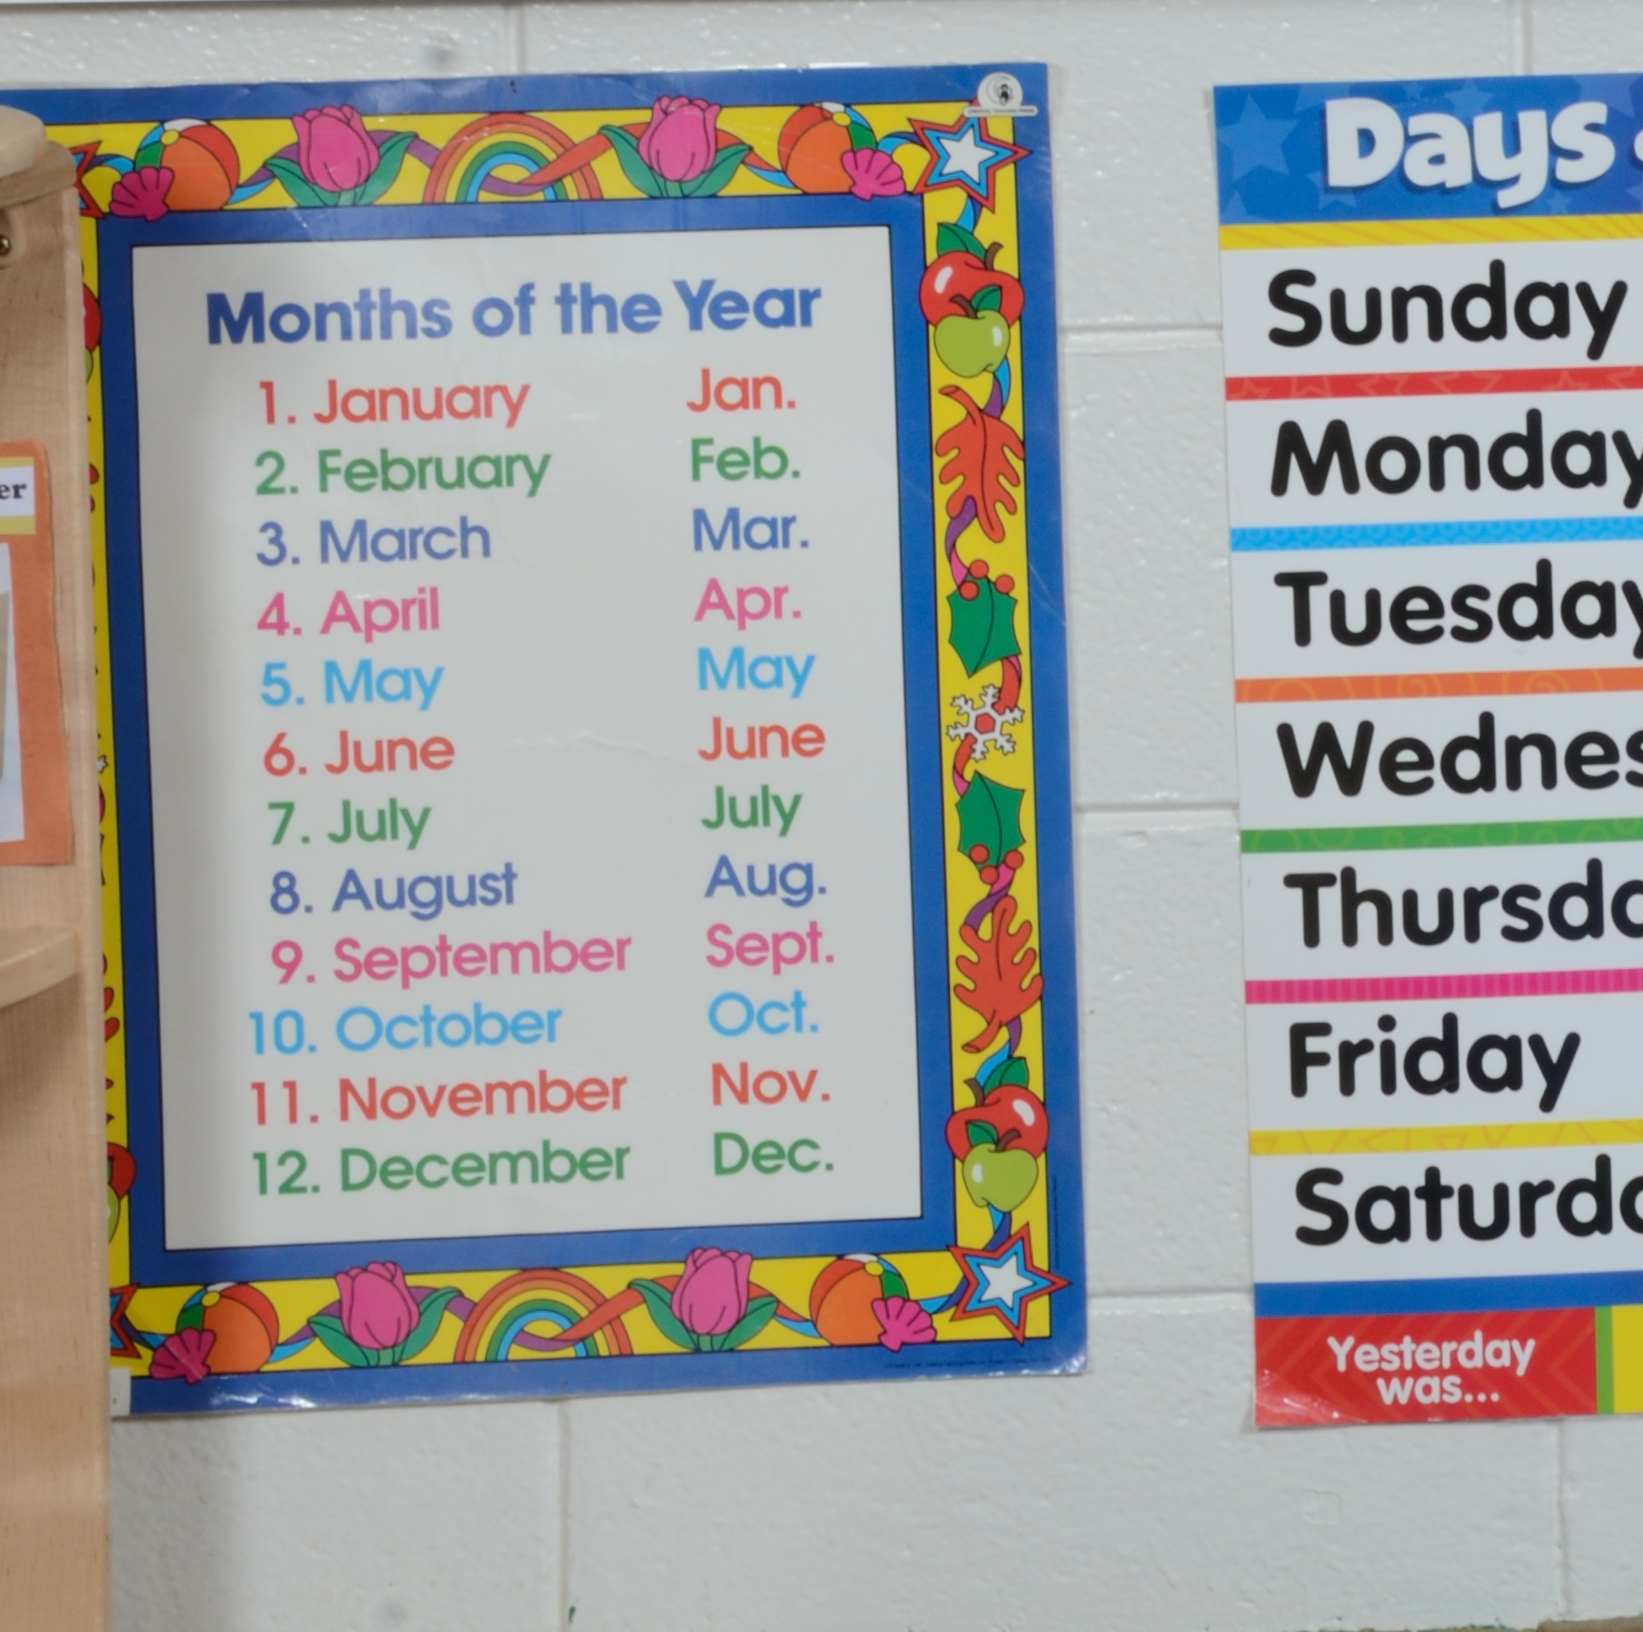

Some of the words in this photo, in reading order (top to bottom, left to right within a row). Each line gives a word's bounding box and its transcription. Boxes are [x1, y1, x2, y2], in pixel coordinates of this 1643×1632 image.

[1323, 98, 1615, 208] Days
[205, 289, 452, 346] Months
[472, 282, 536, 338] of
[554, 282, 662, 334] the
[673, 279, 821, 331] Year
[1268, 259, 1628, 360] Sunday
[259, 381, 296, 425] 1.
[313, 379, 530, 428] January
[687, 368, 796, 413] Jan.
[255, 450, 298, 495] 2.
[318, 448, 551, 497] February
[691, 436, 800, 482] Feb.
[256, 521, 300, 567] 3.
[320, 515, 491, 564] March
[693, 507, 808, 552] Mar.
[257, 592, 302, 636] 4.
[320, 586, 439, 643] April
[694, 578, 801, 631] Apr.
[261, 661, 305, 707] 5.
[323, 658, 445, 712] May
[697, 646, 816, 699] May
[263, 732, 307, 777] 6.
[325, 730, 455, 775] June
[698, 716, 826, 761] June
[268, 801, 310, 845] 7.
[327, 797, 431, 850] July
[701, 784, 803, 837] July
[270, 870, 313, 915] 8.
[332, 862, 518, 921] August
[705, 854, 826, 908] Aug.
[271, 940, 315, 984] 9.
[334, 930, 632, 990] September
[706, 920, 834, 976] Sept.
[249, 1009, 317, 1055] 10.
[335, 1001, 563, 1052] October
[708, 989, 819, 1037] Oct.
[251, 1080, 318, 1126] 11.
[339, 1070, 627, 1122] November
[712, 1062, 830, 1106] Nov.
[1289, 1012, 1580, 1113] Friday
[252, 1150, 320, 1195] 12.
[340, 1139, 630, 1192] December
[714, 1132, 833, 1176] Dec.
[1326, 1331, 1535, 1376] Yesterday
[1376, 1371, 1500, 1407] was...
